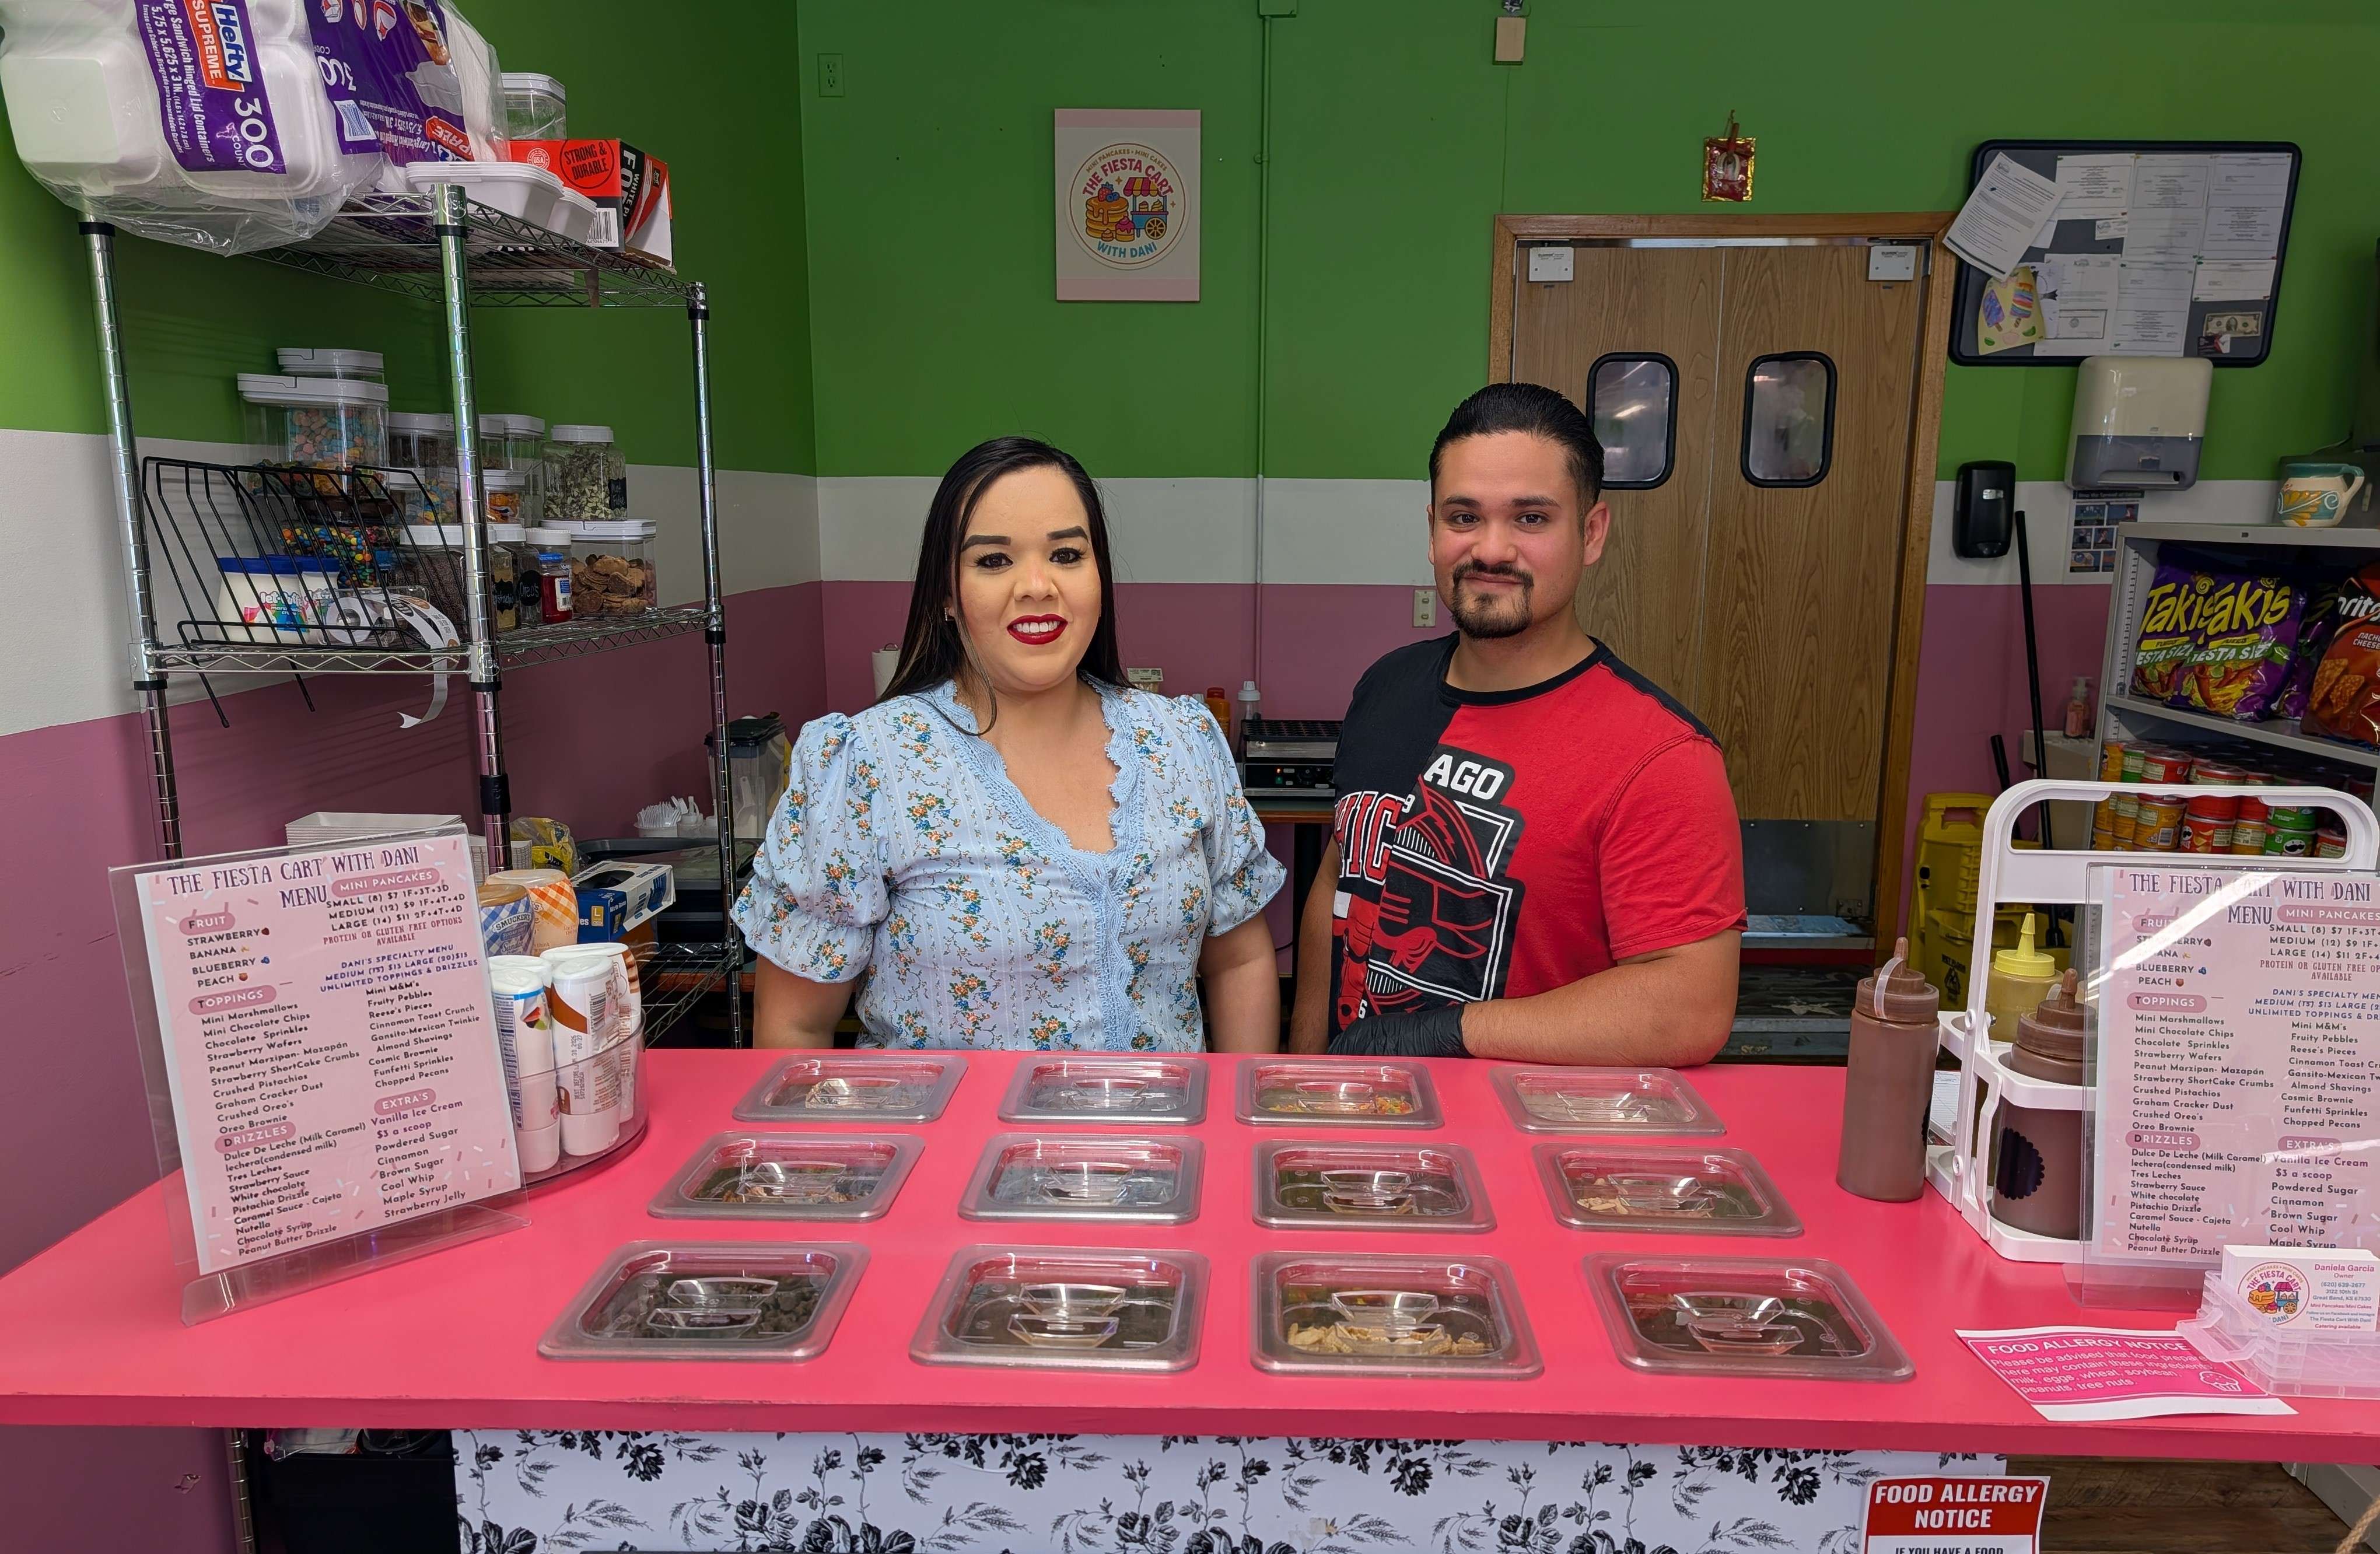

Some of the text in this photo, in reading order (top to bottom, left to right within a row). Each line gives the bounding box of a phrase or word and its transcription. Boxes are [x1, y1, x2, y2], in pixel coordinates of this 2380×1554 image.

[152, 6, 167, 29] 5.75
[160, 37, 178, 66] 5.625
[192, 0, 222, 79] SUPREME
[215, 6, 246, 79] Hefty
[172, 18, 215, 162] Sandwich Hinged Lid Containers
[234, 97, 274, 168] 300
[533, 156, 545, 164] USA
[564, 142, 607, 165] STRONG &
[1086, 149, 1168, 173] MINI PANCAKES MINI CAKES
[571, 160, 609, 181] DURABLE
[1082, 158, 1174, 197] THE FIESTA CART
[626, 173, 640, 206] WHITE
[1097, 240, 1158, 258] WITH DANI
[1423, 754, 1504, 800] AGO
[166, 846, 419, 894] THE FIESTA CART WITH DANI
[340, 870, 433, 891] MINI PANCAKES
[2129, 873, 2160, 892] THE
[2282, 880, 2323, 899] WITH
[2332, 882, 2370, 901] DANI
[279, 885, 330, 908] MENU
[594, 908, 601, 916] L
[2227, 905, 2273, 926] MENU
[2286, 909, 2380, 921] MINI PANCAKES
[188, 915, 226, 929] FRUIT
[495, 912, 531, 931] SMUCKER'S
[2269, 923, 2305, 933] SMALL
[2311, 926, 2325, 935] (8)
[187, 928, 260, 946] STRAWBERRY
[2270, 936, 2357, 947] MEDIUM (12) $9
[189, 946, 236, 960] BANANA
[2270, 948, 2349, 959] LARGE (14) $11
[192, 957, 256, 975] BLUEBERRY
[197, 975, 234, 988] PEACH
[197, 989, 264, 1010] TOPPINGS
[2136, 996, 2194, 1007] TOPPINGS
[201, 1003, 298, 1026] Mini Marshmallows
[2158, 1026, 2204, 1036] Chocolate
[2208, 1028, 2234, 1038] Chips
[2291, 1032, 2358, 1043] Fruity Pebbles
[213, 1074, 307, 1097] Crushed Pistachios
[215, 1082, 323, 1110] Graham Cracker Dust
[382, 1091, 429, 1110] EXTRA'S
[2281, 1093, 2353, 1103] Cosmic Brownie
[2283, 1116, 2360, 1128] Chopped Pecans
[223, 1125, 287, 1147] DRIZZLES
[374, 1128, 458, 1153] Powdered Sugar
[377, 1149, 429, 1166] Cinnamon
[227, 1165, 282, 1182] Tres Leches
[384, 1190, 466, 1217] Strawberry Jelly
[2271, 1196, 2323, 1206] Cinnamon
[2270, 1209, 2337, 1224] Brown Sugar
[235, 1220, 270, 1235] Nutella
[2270, 1223, 2325, 1236] Cool Whip
[2246, 1277, 2260, 1290] THE
[2259, 1270, 2285, 1281] FIESTA
[2286, 1275, 2302, 1292] CART
[2272, 1314, 2290, 1324] DANI
[1987, 1338, 2191, 1354] FOOD ALLERGY NOTICE
[1990, 1358, 2035, 1367] Please
[2035, 1356, 2054, 1364] be
[2056, 1351, 2104, 1362] advised
[2105, 1350, 2130, 1359] that
[1999, 1368, 2031, 1376] here
[2032, 1366, 2060, 1374] may
[2062, 1359, 2109, 1371] contain
[2108, 1359, 2146, 1367] these
[2077, 1381, 2104, 1391] tree
[1875, 1484, 2039, 1504] FOOD ALLERGY
[1915, 1508, 1992, 1529] NOTICE
